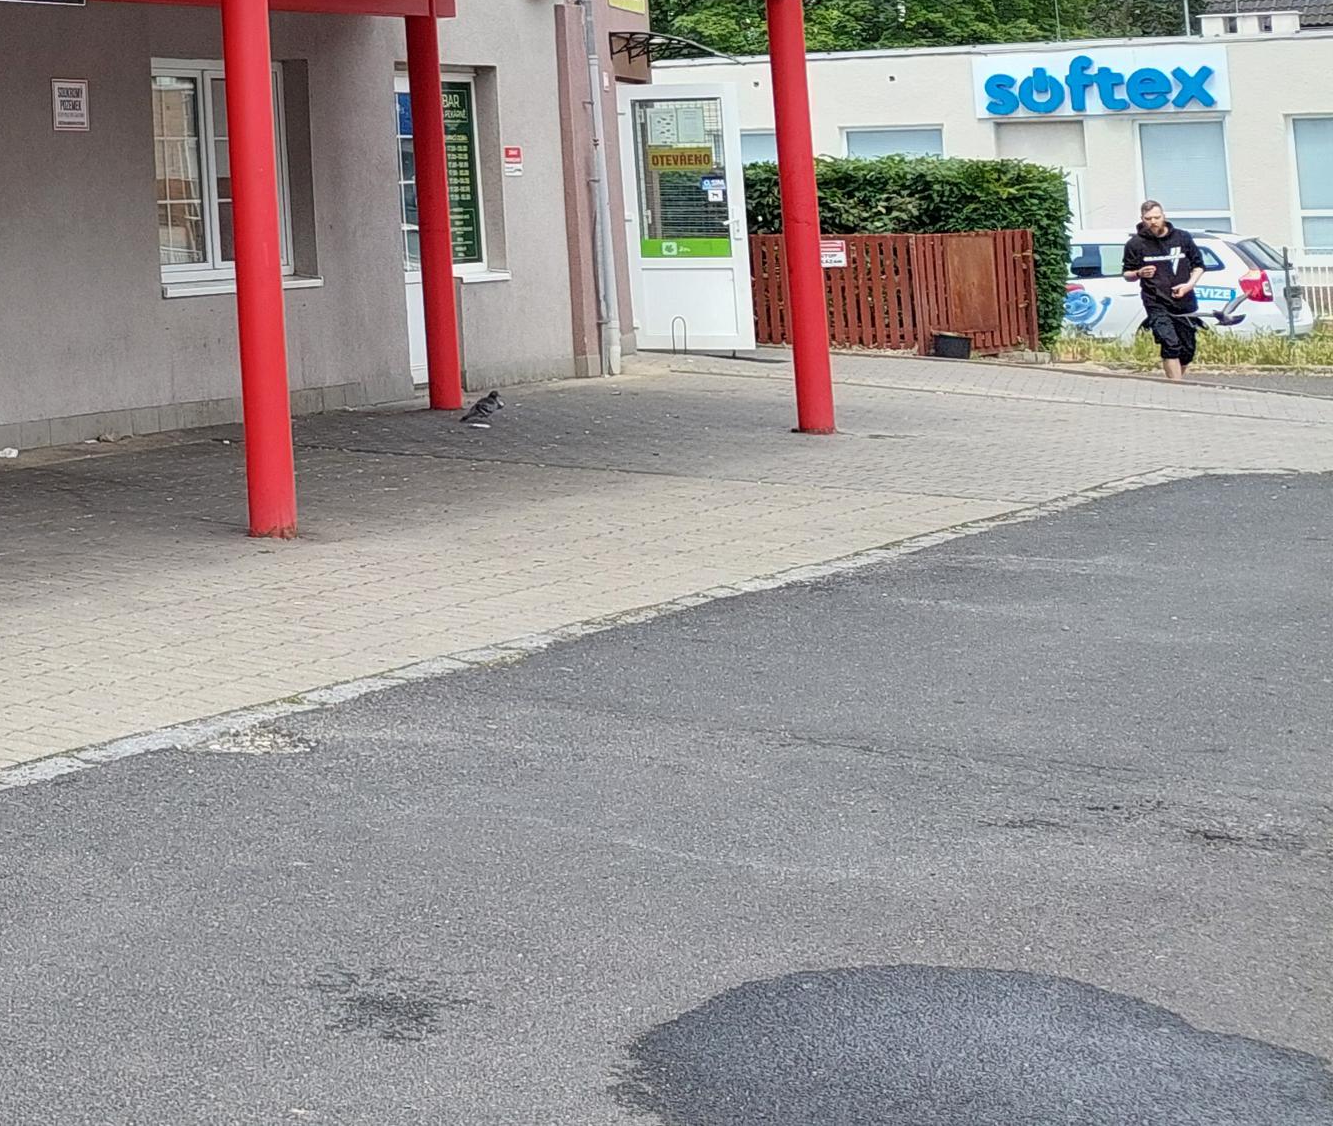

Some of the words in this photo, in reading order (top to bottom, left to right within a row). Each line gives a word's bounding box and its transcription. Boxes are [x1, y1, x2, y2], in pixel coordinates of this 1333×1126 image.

[983, 55, 1217, 116] softex
[60, 99, 82, 111] POZEMEK
[442, 94, 460, 108] BAR
[651, 151, 711, 167] OTEVŘENO
